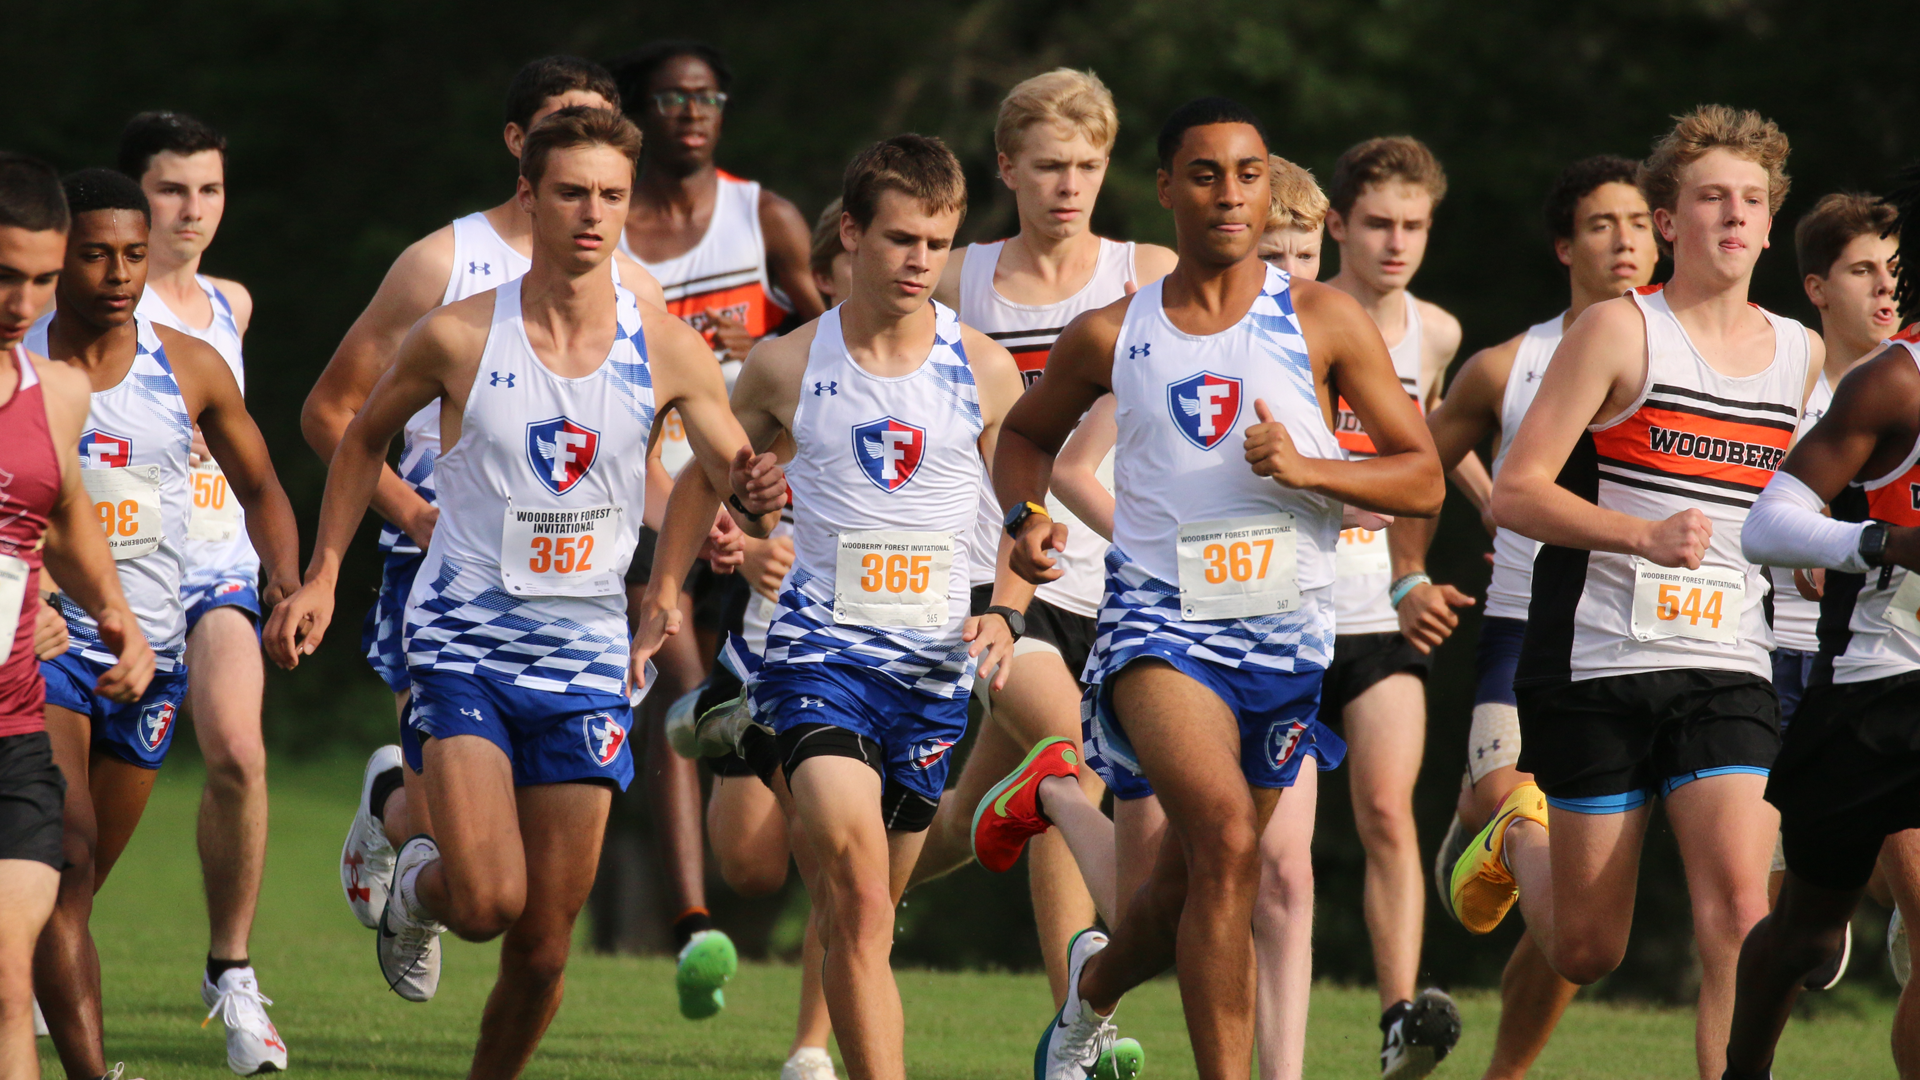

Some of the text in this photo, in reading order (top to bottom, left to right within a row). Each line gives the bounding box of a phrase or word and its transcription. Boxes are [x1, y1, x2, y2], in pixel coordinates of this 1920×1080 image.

[1649, 425, 1786, 472] WOODBERR
[190, 473, 226, 510] 50
[94, 499, 139, 537] 36
[517, 508, 611, 523] WOODBERRY FOREST
[533, 521, 594, 534] INVITATIONAL
[1181, 526, 1291, 543] WOODBERRY FOREST INVITATIONAL
[120, 536, 158, 547] WOODBERRY
[842, 542, 883, 550] WOODBERRY
[529, 535, 594, 574] 352
[1203, 538, 1274, 584] 367
[861, 553, 932, 593] 365
[1641, 571, 1741, 590] WOODBERRY FOREST INVITATIONAL
[1277, 600, 1289, 609] 367
[1657, 584, 1723, 628] 544
[926, 614, 938, 623] 365
